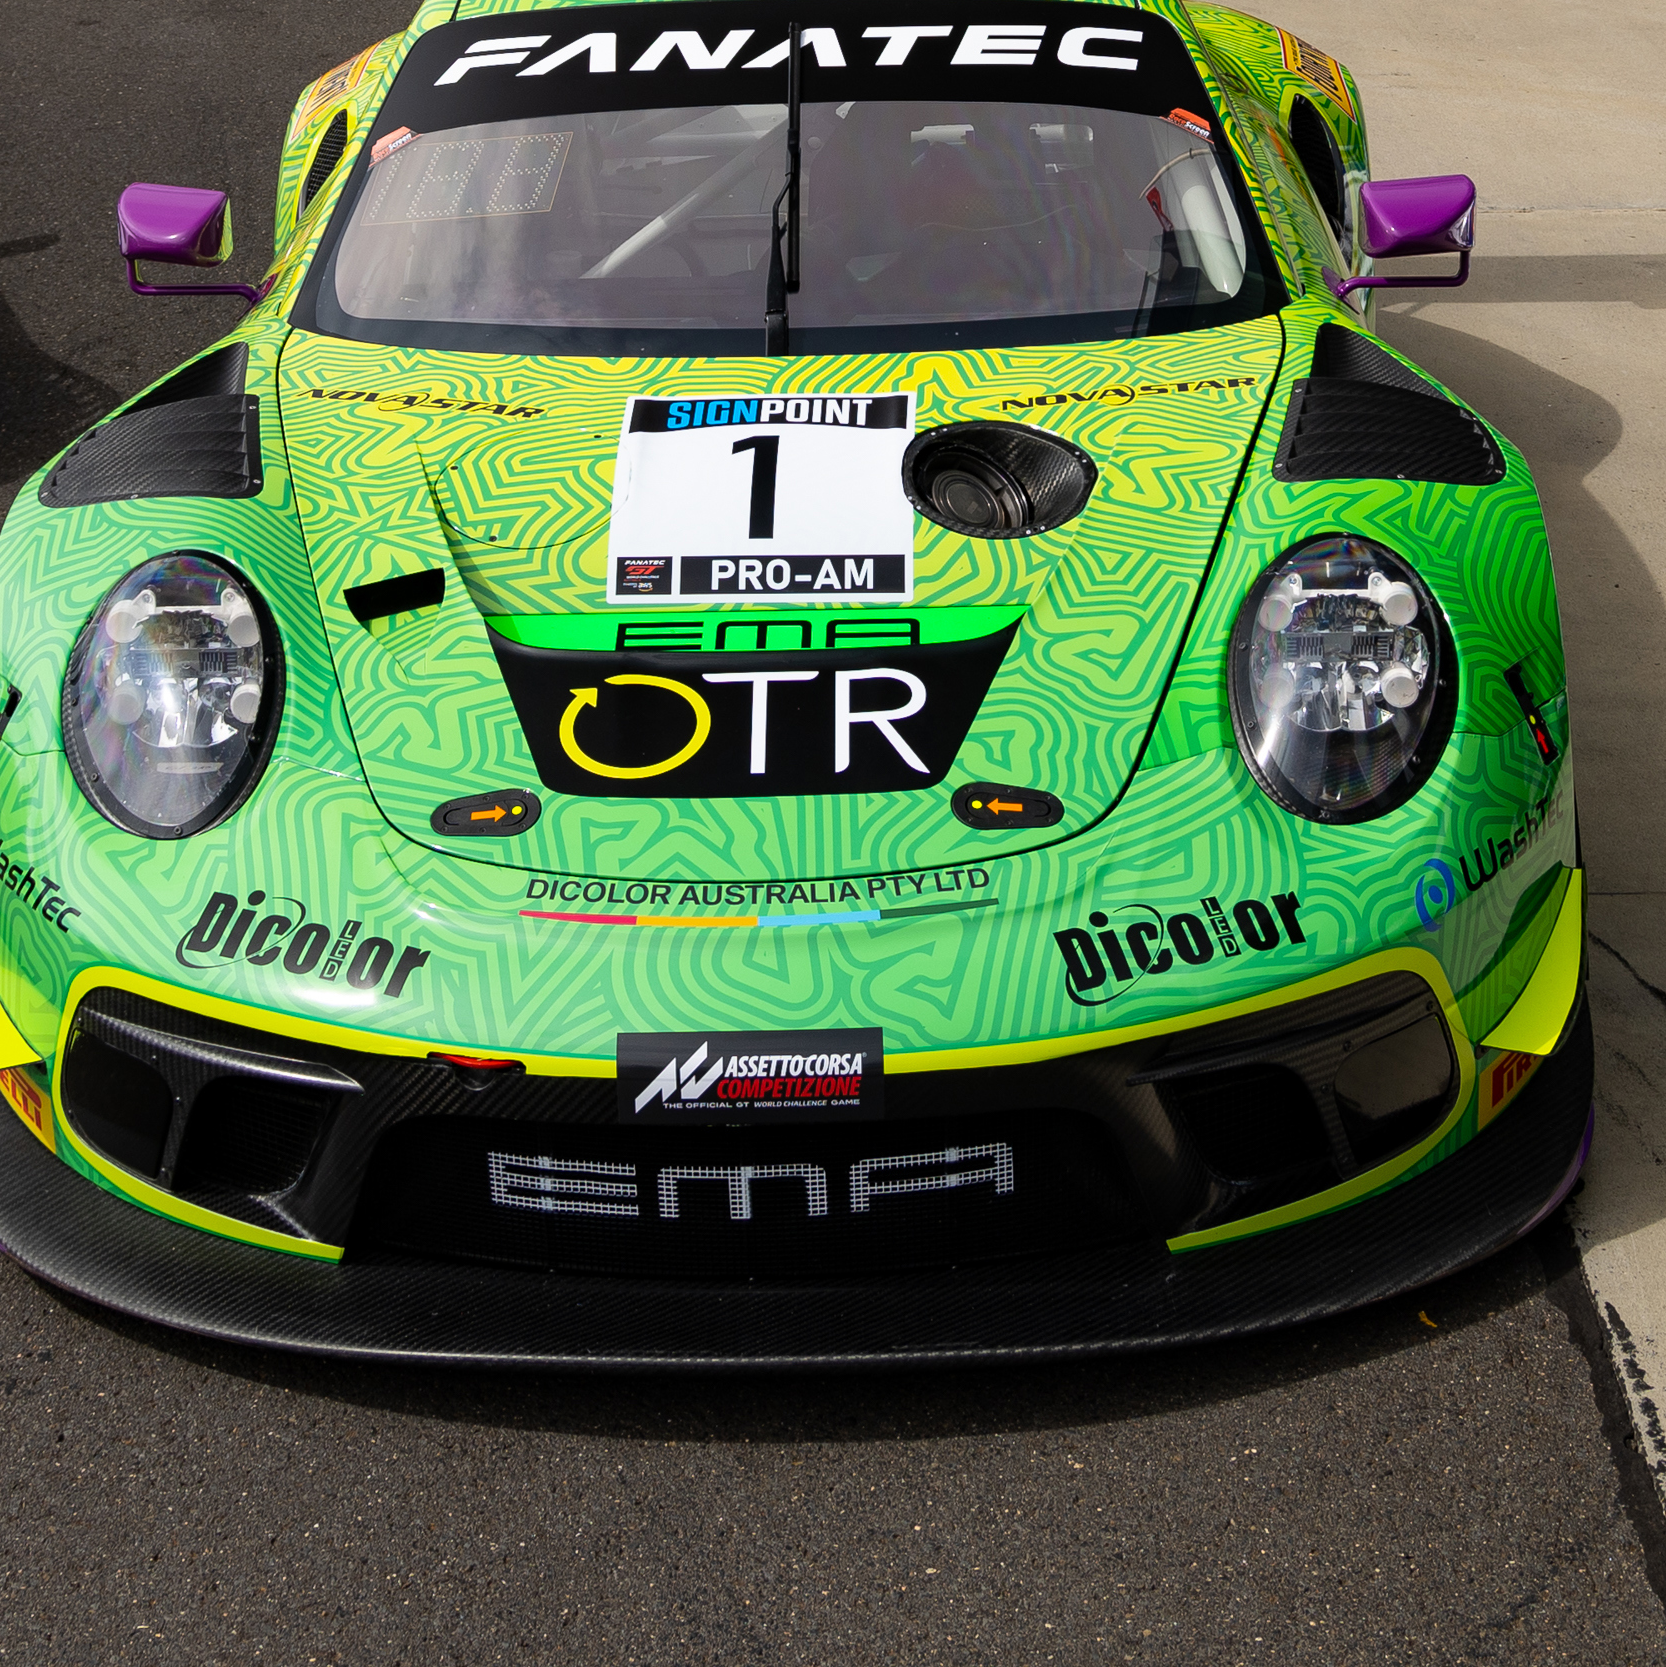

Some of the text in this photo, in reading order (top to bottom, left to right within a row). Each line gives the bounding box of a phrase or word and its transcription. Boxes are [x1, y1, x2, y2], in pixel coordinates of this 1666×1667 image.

[434, 25, 1144, 87] FANATEC
[296, 388, 546, 420] NOVASTAR
[1000, 375, 1258, 413] NOVASTAR
[666, 397, 875, 431] SIGNPOINT
[730, 434, 779, 541] 1
[710, 558, 874, 591] PRO-AM
[615, 617, 921, 652] EMA
[558, 667, 931, 780] OTR
[525, 866, 991, 912] DICOLOR AUSTRALIA PTY LTD
[724, 1052, 863, 1078] ASSETTO CORSA
[685, 1101, 733, 1109] OFFICIAL
[753, 1100, 782, 1108] WORLD
[783, 1099, 828, 1107] CHALLENGE
[830, 1099, 861, 1107] GAME
[716, 1075, 862, 1100] COMPETIZIONE
[487, 1142, 1015, 1220] EMA
